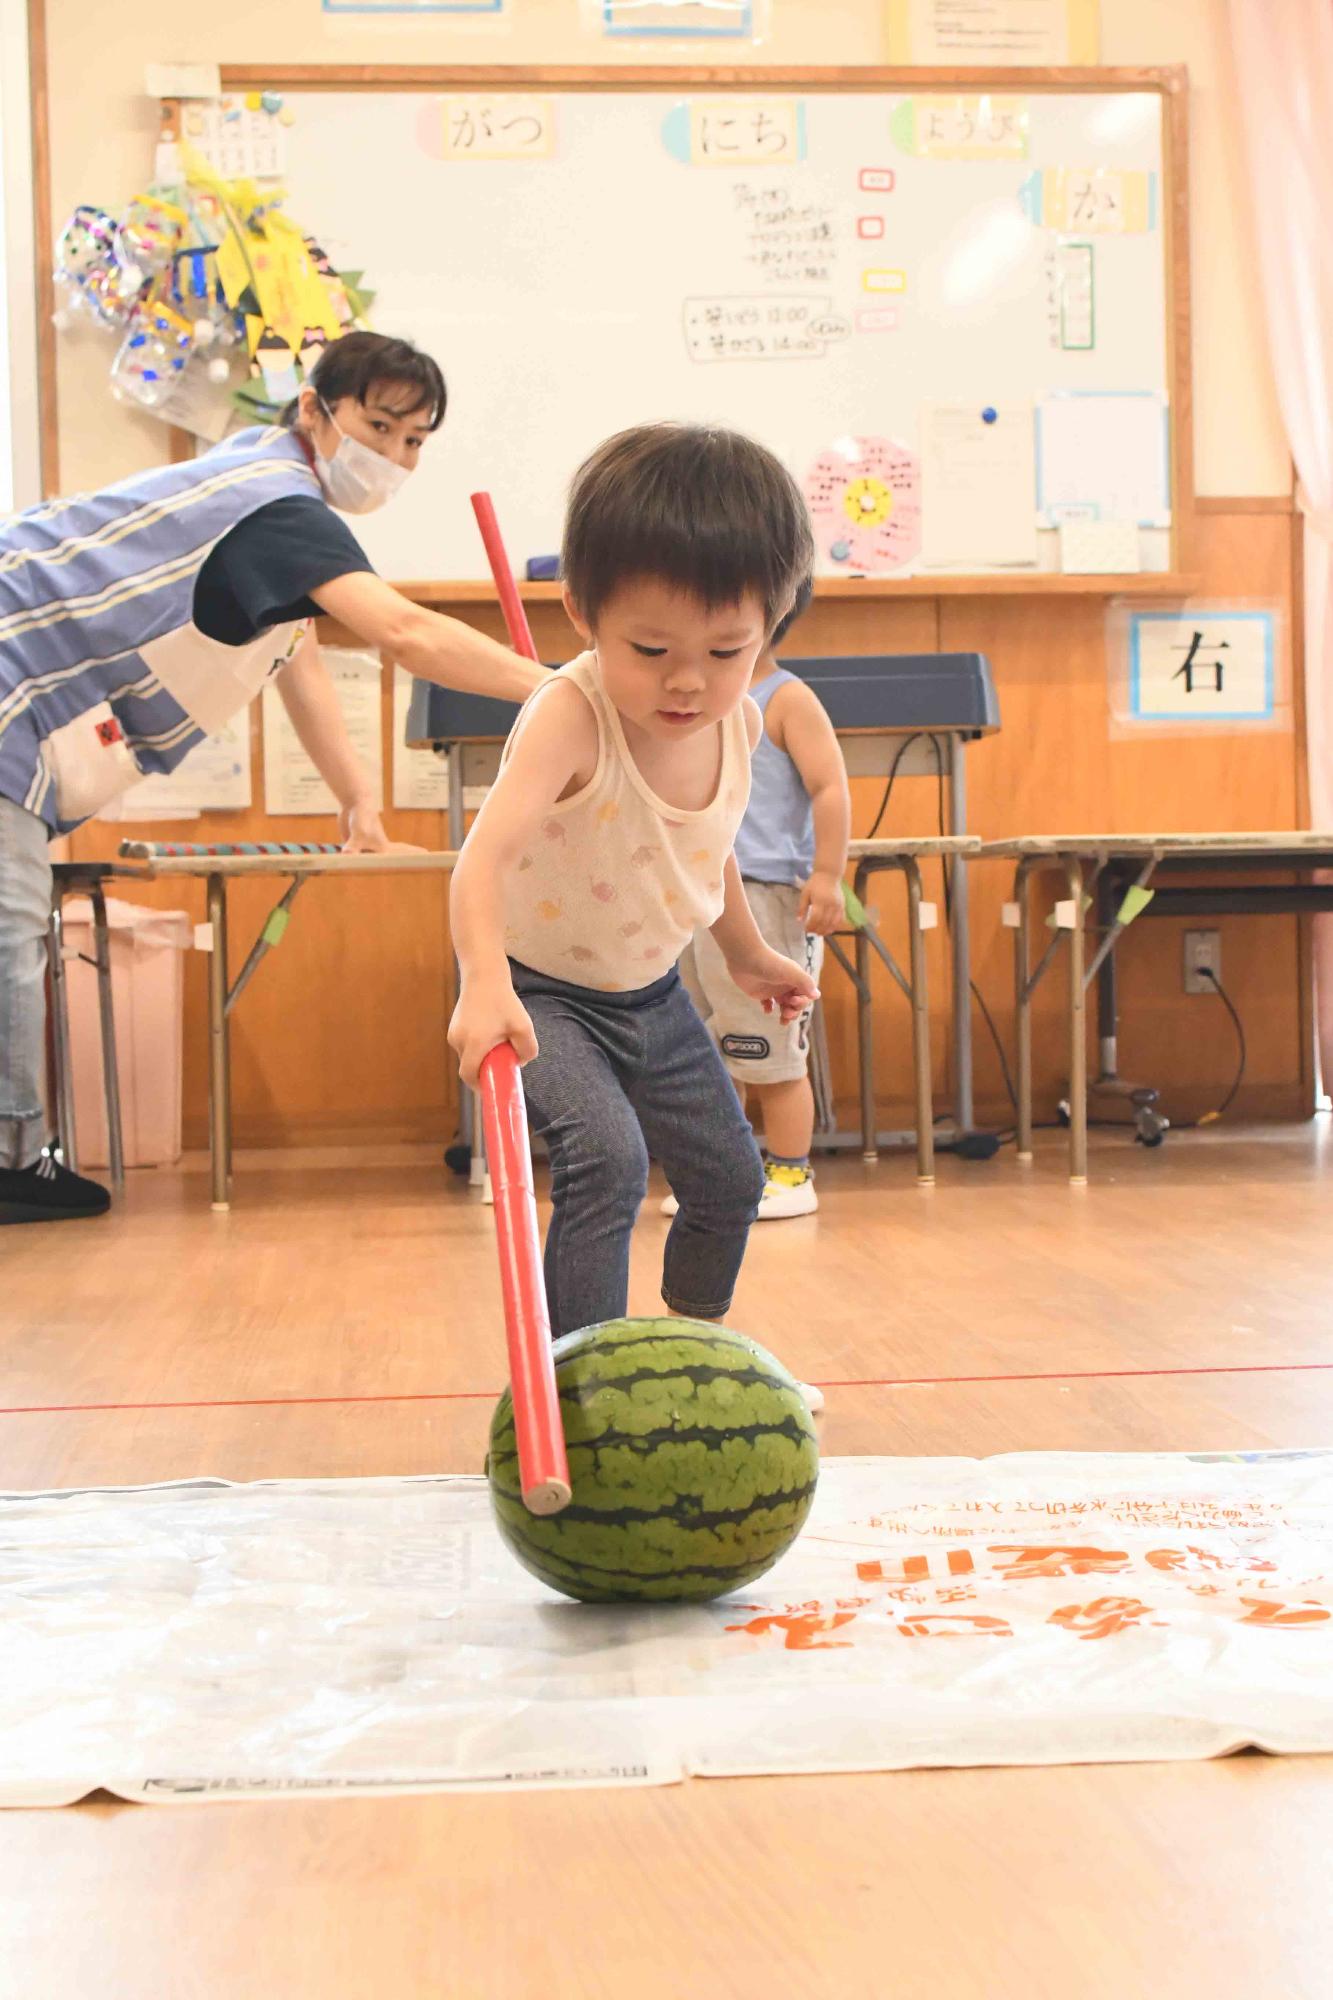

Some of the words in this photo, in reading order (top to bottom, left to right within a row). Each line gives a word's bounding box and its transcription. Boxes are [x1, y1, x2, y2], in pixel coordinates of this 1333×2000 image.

[450, 108, 543, 149] がつ
[700, 110, 788, 154] にち
[928, 112, 1016, 143] ようび
[1072, 181, 1117, 220] か
[1169, 630, 1232, 693] 右
